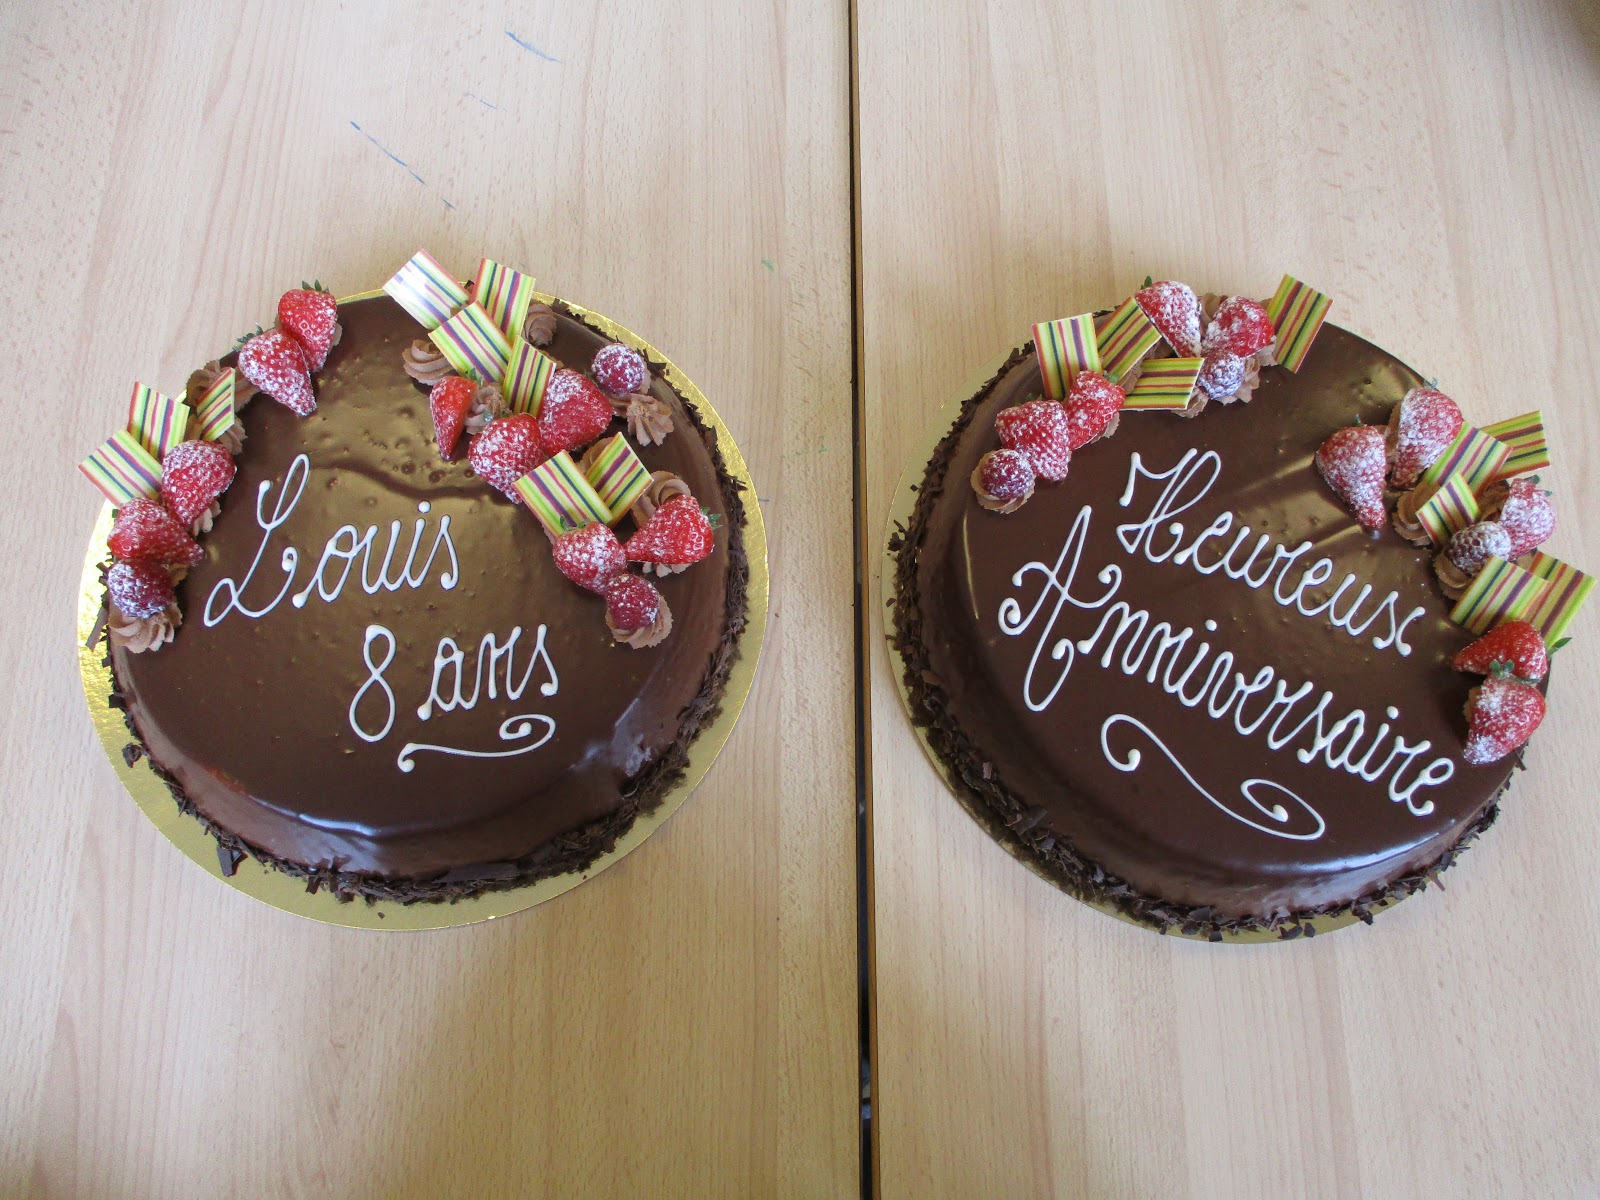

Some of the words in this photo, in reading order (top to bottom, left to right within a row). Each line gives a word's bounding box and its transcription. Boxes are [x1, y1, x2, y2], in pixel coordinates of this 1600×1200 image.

[203, 453, 459, 609] Louis
[1116, 447, 1426, 656] Heureux
[348, 623, 397, 743] 8
[417, 622, 560, 721] ans
[998, 504, 1455, 817] Anniversaire
